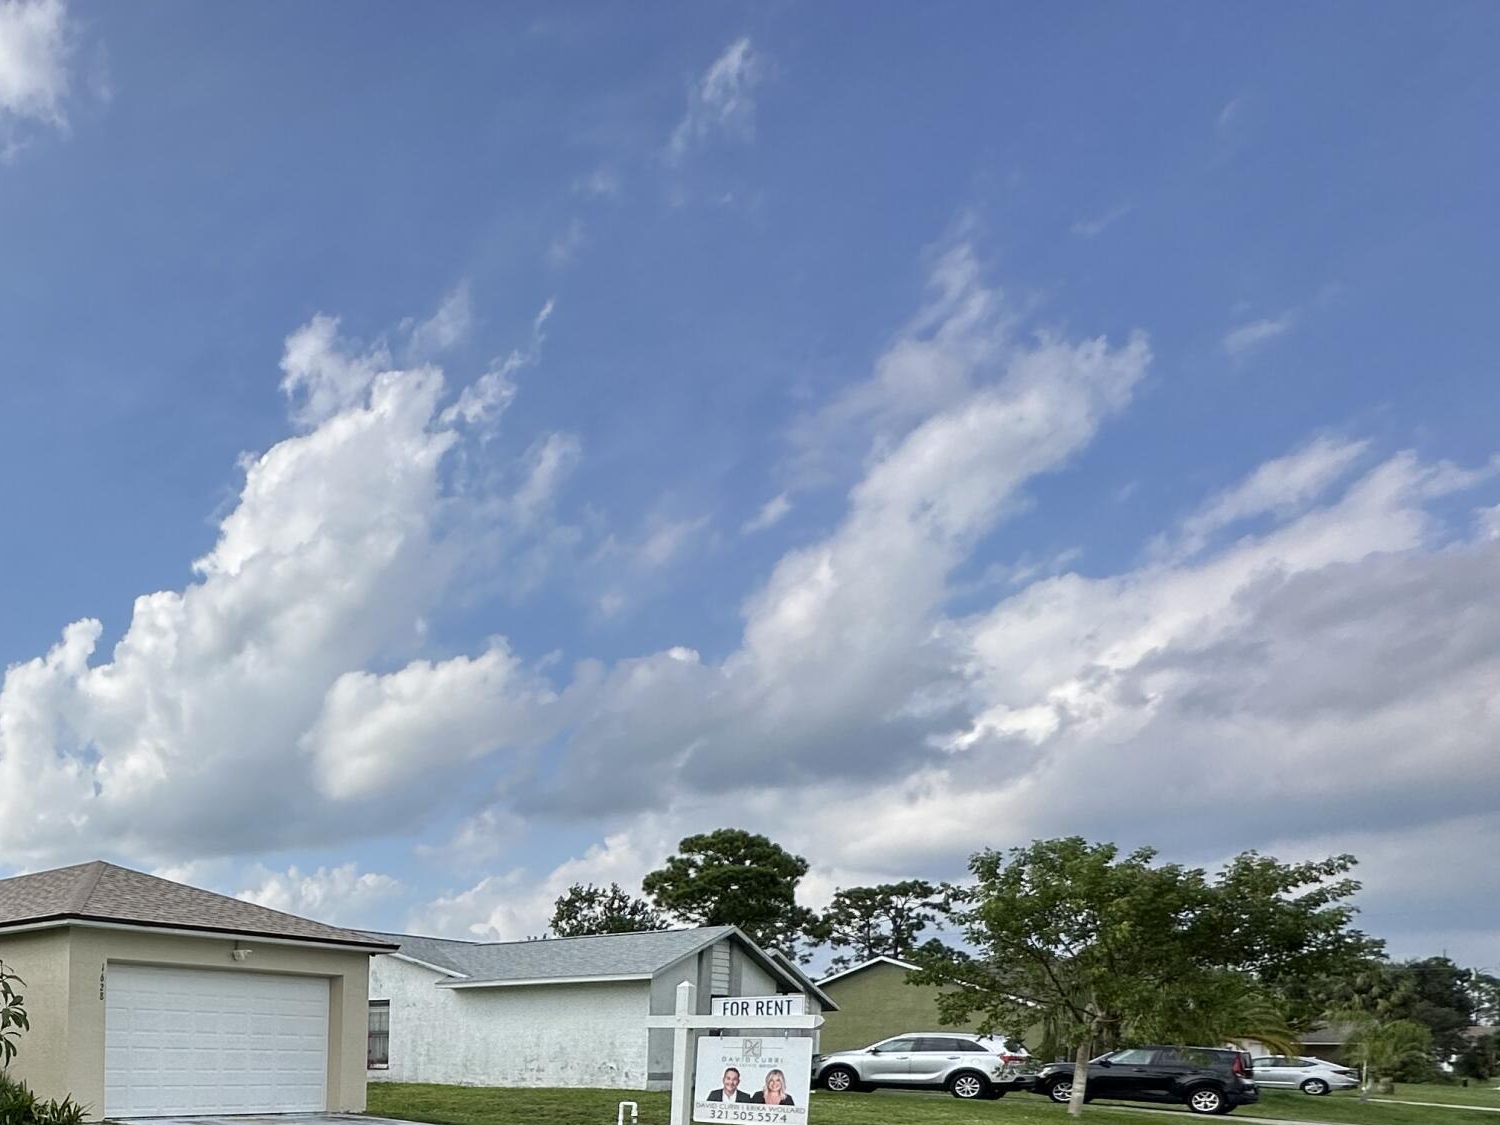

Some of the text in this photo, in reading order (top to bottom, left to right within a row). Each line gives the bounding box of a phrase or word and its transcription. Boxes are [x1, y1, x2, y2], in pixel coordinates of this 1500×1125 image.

[723, 1000, 793, 1016] FOR RENT
[710, 1110, 787, 1122] 321.505.5574
[769, 1106, 806, 1114] WOLLARD
